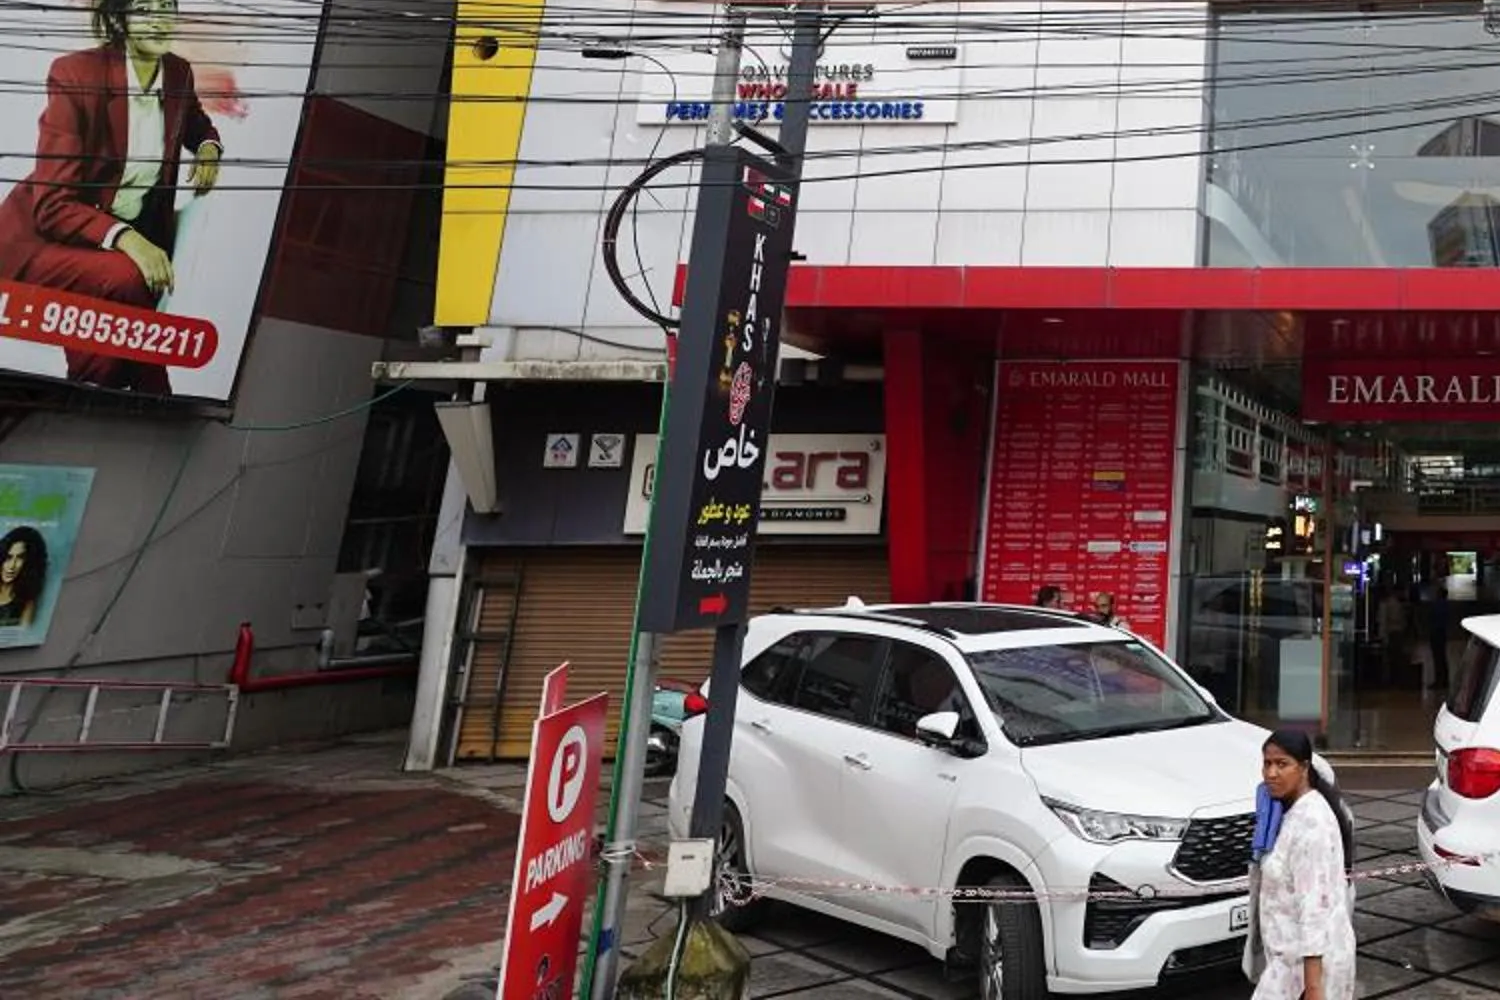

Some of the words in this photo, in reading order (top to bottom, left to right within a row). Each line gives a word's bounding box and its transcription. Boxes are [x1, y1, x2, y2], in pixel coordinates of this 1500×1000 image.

[808, 102, 924, 120] CCESSORIES
[742, 233, 767, 351] KHAS
[41, 302, 206, 358] 9895332211
[1030, 371, 1116, 388] EMARALD
[1123, 371, 1171, 388] MALL
[703, 423, 760, 480] خاص
[557, 741, 582, 809] P
[525, 829, 587, 894] PARKING
